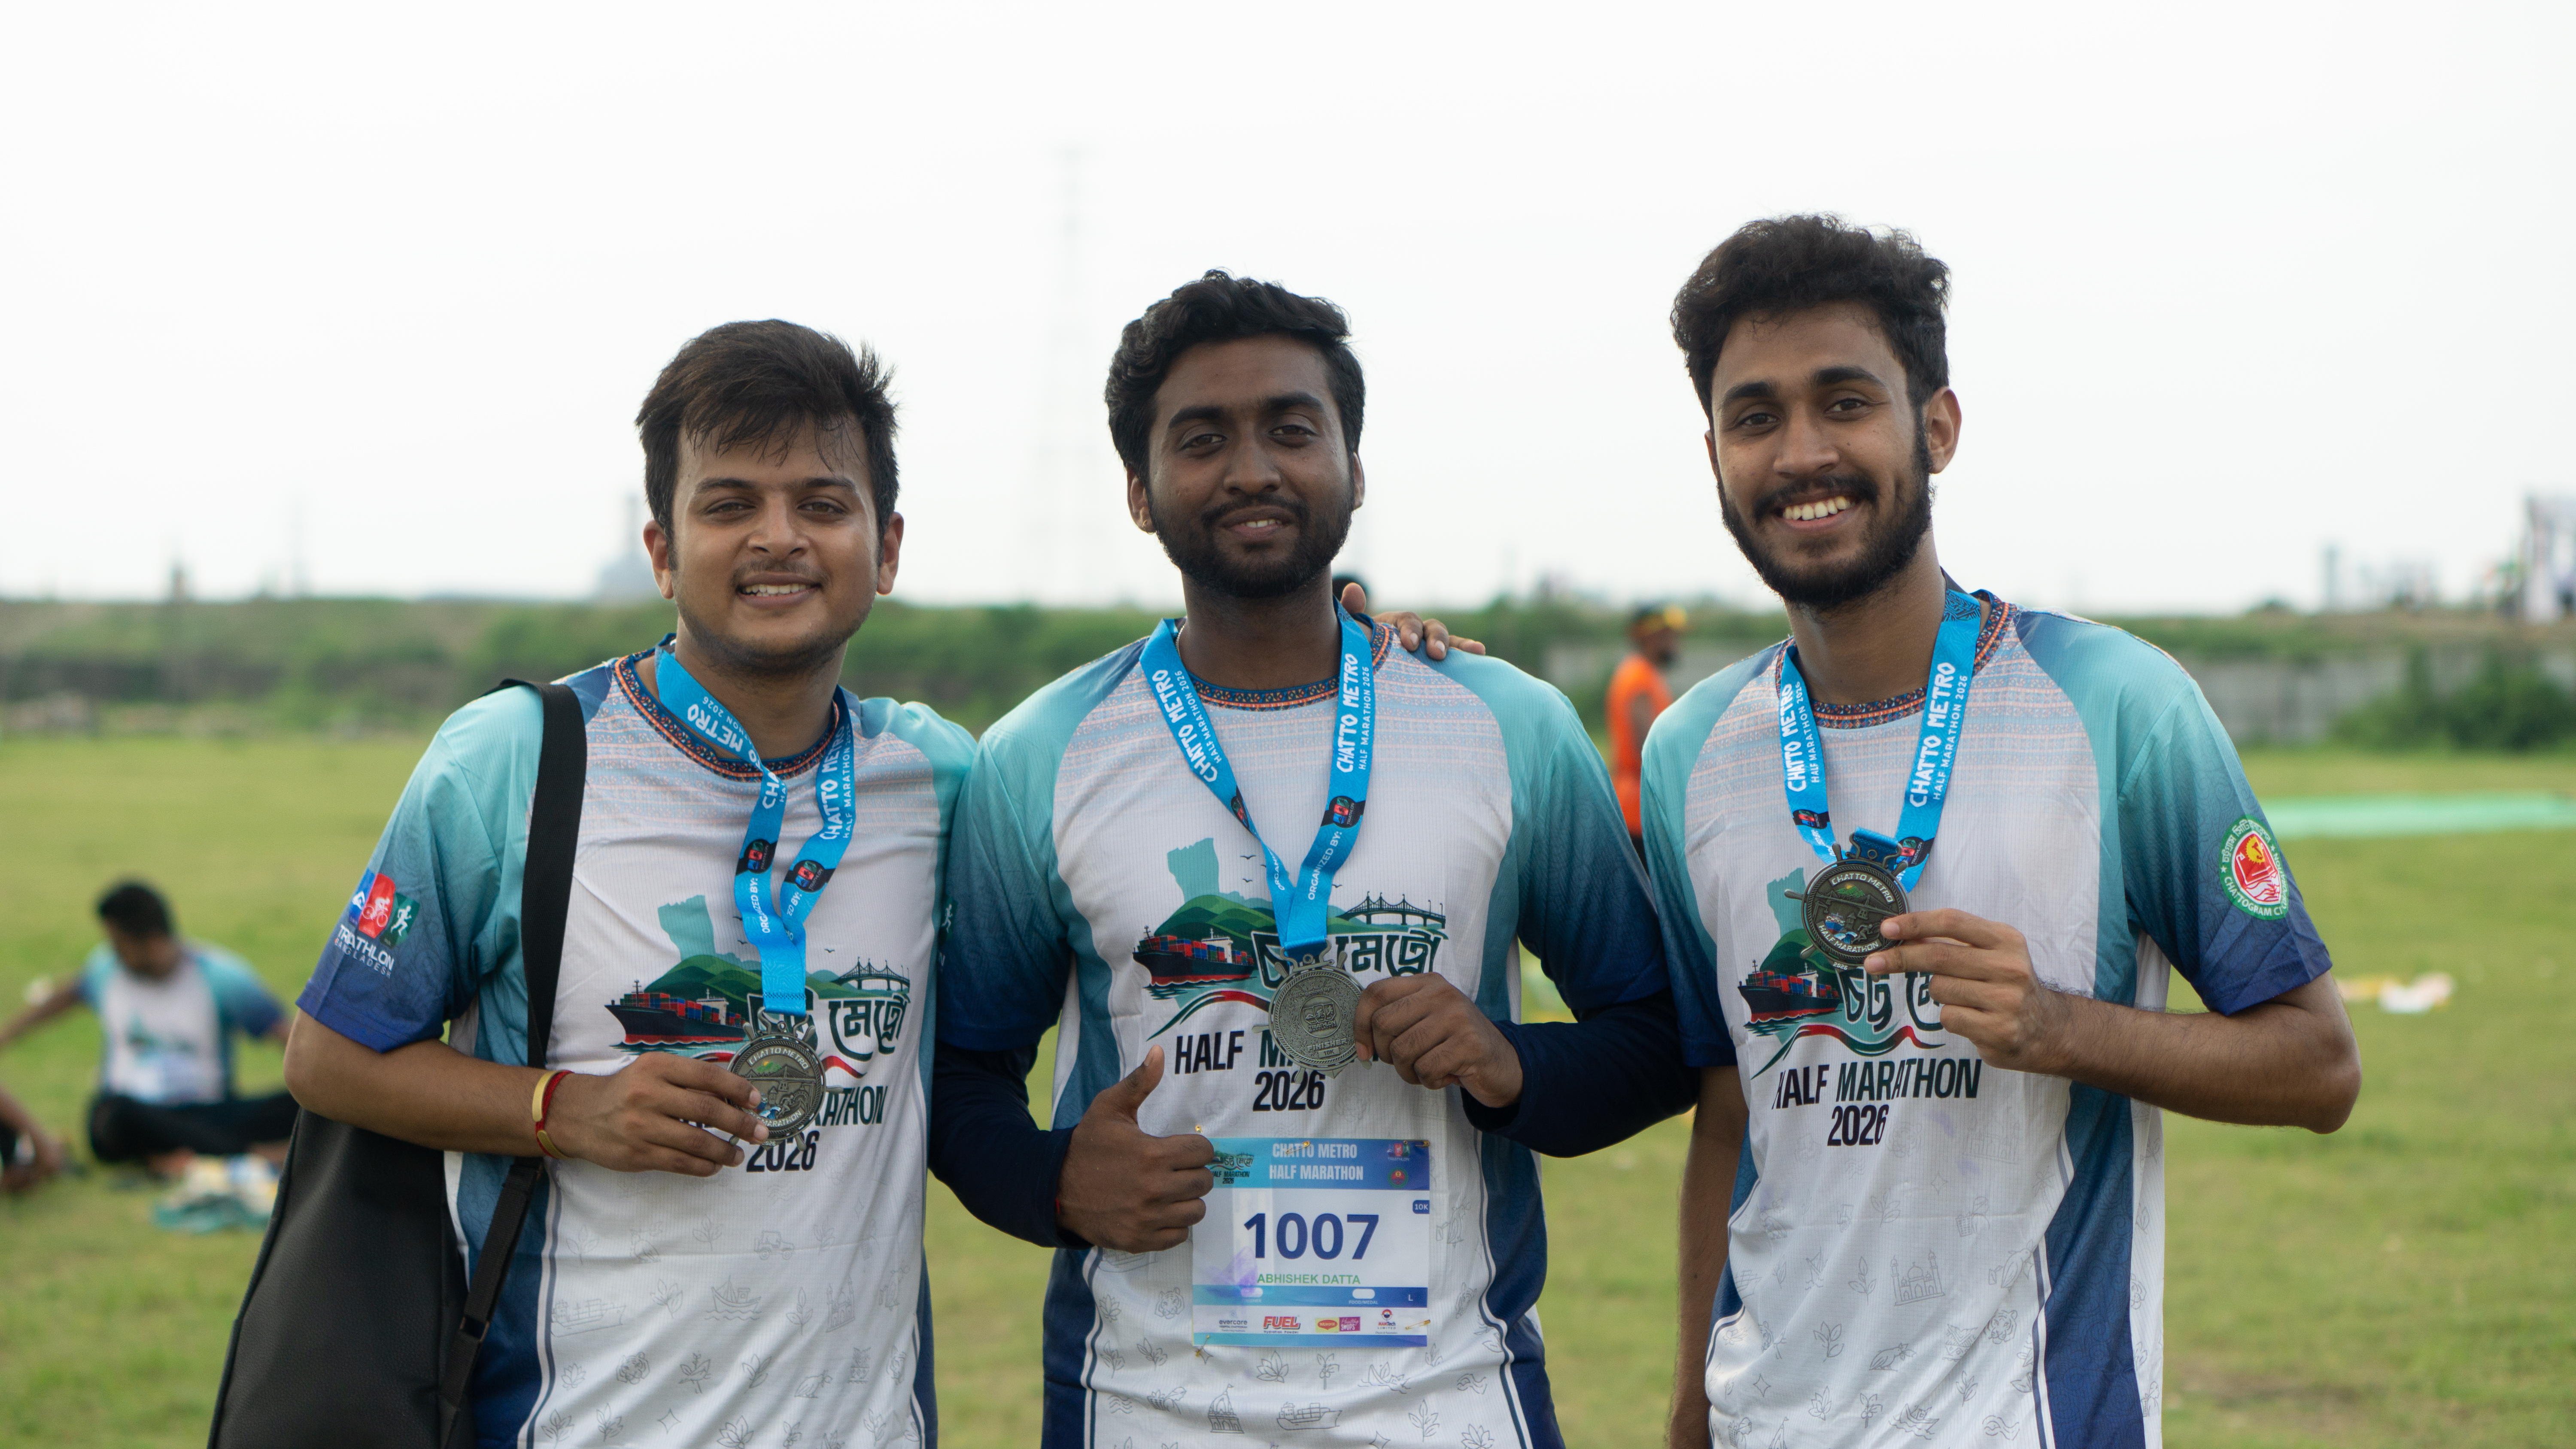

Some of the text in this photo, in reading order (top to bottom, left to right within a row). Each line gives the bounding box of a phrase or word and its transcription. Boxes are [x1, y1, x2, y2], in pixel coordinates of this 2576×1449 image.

[702, 696, 724, 717] 2026
[1152, 670, 1218, 782] CHATTO METRO
[1175, 670, 1222, 764] HALF MARATHON 2026
[1337, 653, 1359, 773] CHATTO METRO
[1361, 689, 1371, 745] MARATHON
[687, 704, 743, 752] METRO
[1782, 684, 1807, 792] CHATTO METRO
[1795, 681, 1820, 783] HALF MARATHON 2026
[1910, 662, 1956, 807] CHATTO METRO
[1933, 676, 1968, 800] HALF MARATHON 2026
[842, 747, 851, 807] MARATHON
[1358, 749, 1367, 770] HALF
[820, 725, 844, 840] CHATTO METRO
[843, 812, 852, 838] HALF
[750, 877, 759, 893] BY:
[1308, 831, 1342, 900] ORGANIZED BY:
[790, 891, 802, 906] BY:
[1831, 873, 1893, 903] CHATTO METRO
[2224, 876, 2272, 916] CHATTOGRAM
[338, 924, 395, 971] TRIATHLON
[1818, 925, 1879, 953] HALF MARATHON
[1833, 962, 1848, 970] 2026
[749, 1048, 809, 1070] CHATTO METRO
[1175, 1031, 1244, 1074] HALF
[1307, 1038, 1347, 1051] FINISHER
[1252, 1071, 1326, 1111] 2026
[1772, 1058, 1982, 1110] HALF MARATHON
[762, 1110, 802, 1127] MARATHON
[1827, 1105, 1889, 1146] 2026
[746, 1130, 820, 1172] 2026
[1273, 1143, 1357, 1158] CHATTO METRO
[1270, 1165, 1364, 1180] HALF MARATHON
[1244, 1213, 1379, 1260] 1007
[1257, 1273, 1361, 1285] ABHISHEK DATTA
[1263, 1316, 1301, 1329] FUEL
